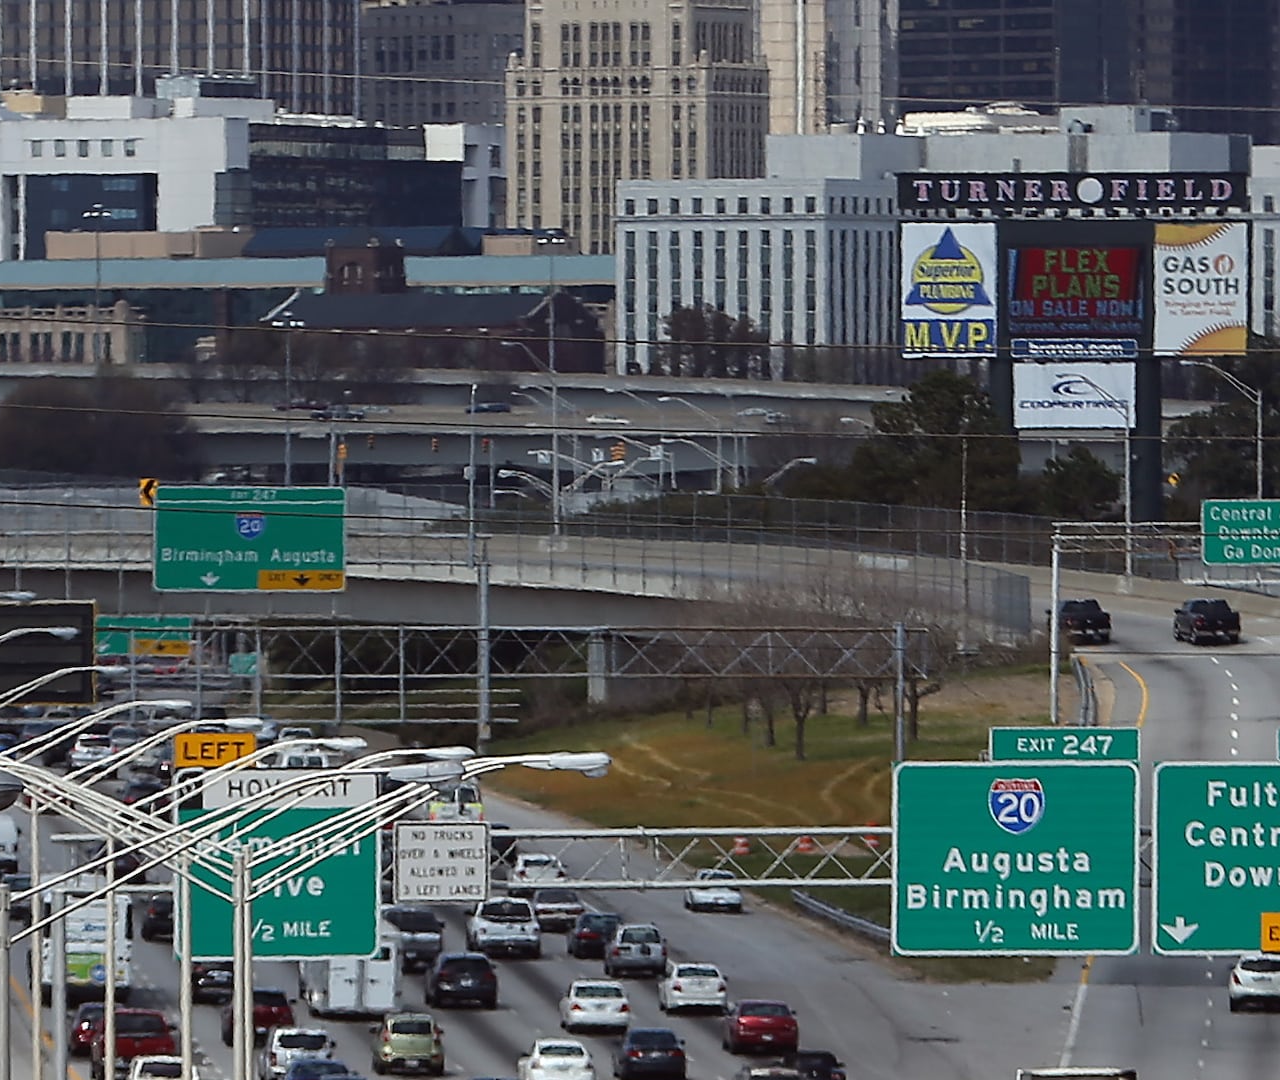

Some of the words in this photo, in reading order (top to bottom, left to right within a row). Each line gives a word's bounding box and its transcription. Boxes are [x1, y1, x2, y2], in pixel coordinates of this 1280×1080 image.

[912, 179, 1072, 202] TURNER
[1110, 179, 1233, 201] FIELD
[1044, 250, 1109, 273] FLEX
[1163, 255, 1210, 274] GAS
[919, 263, 975, 280] Superior
[1032, 275, 1120, 299] PLANS
[1163, 277, 1239, 295] SOUTH
[1010, 300, 1034, 317] ON
[1042, 300, 1088, 317] SALE
[904, 322, 993, 351] M.V.P.
[252, 490, 277, 500] 247
[1210, 507, 1271, 521] Central
[239, 519, 261, 534] 20
[161, 548, 258, 566] Birmingham
[271, 549, 336, 566] Augusta
[1224, 545, 1244, 560] Ga
[183, 741, 246, 761] LEFT
[1017, 737, 1056, 752] EXIT
[1063, 735, 1113, 756] 247
[297, 778, 351, 797] IT
[997, 793, 1039, 824] 20
[433, 831, 474, 841] TRUCKS
[943, 847, 1091, 880] Augusta
[906, 884, 1127, 917] Birmingham
[283, 920, 332, 938] MILE
[1031, 923, 1079, 941] MILE
